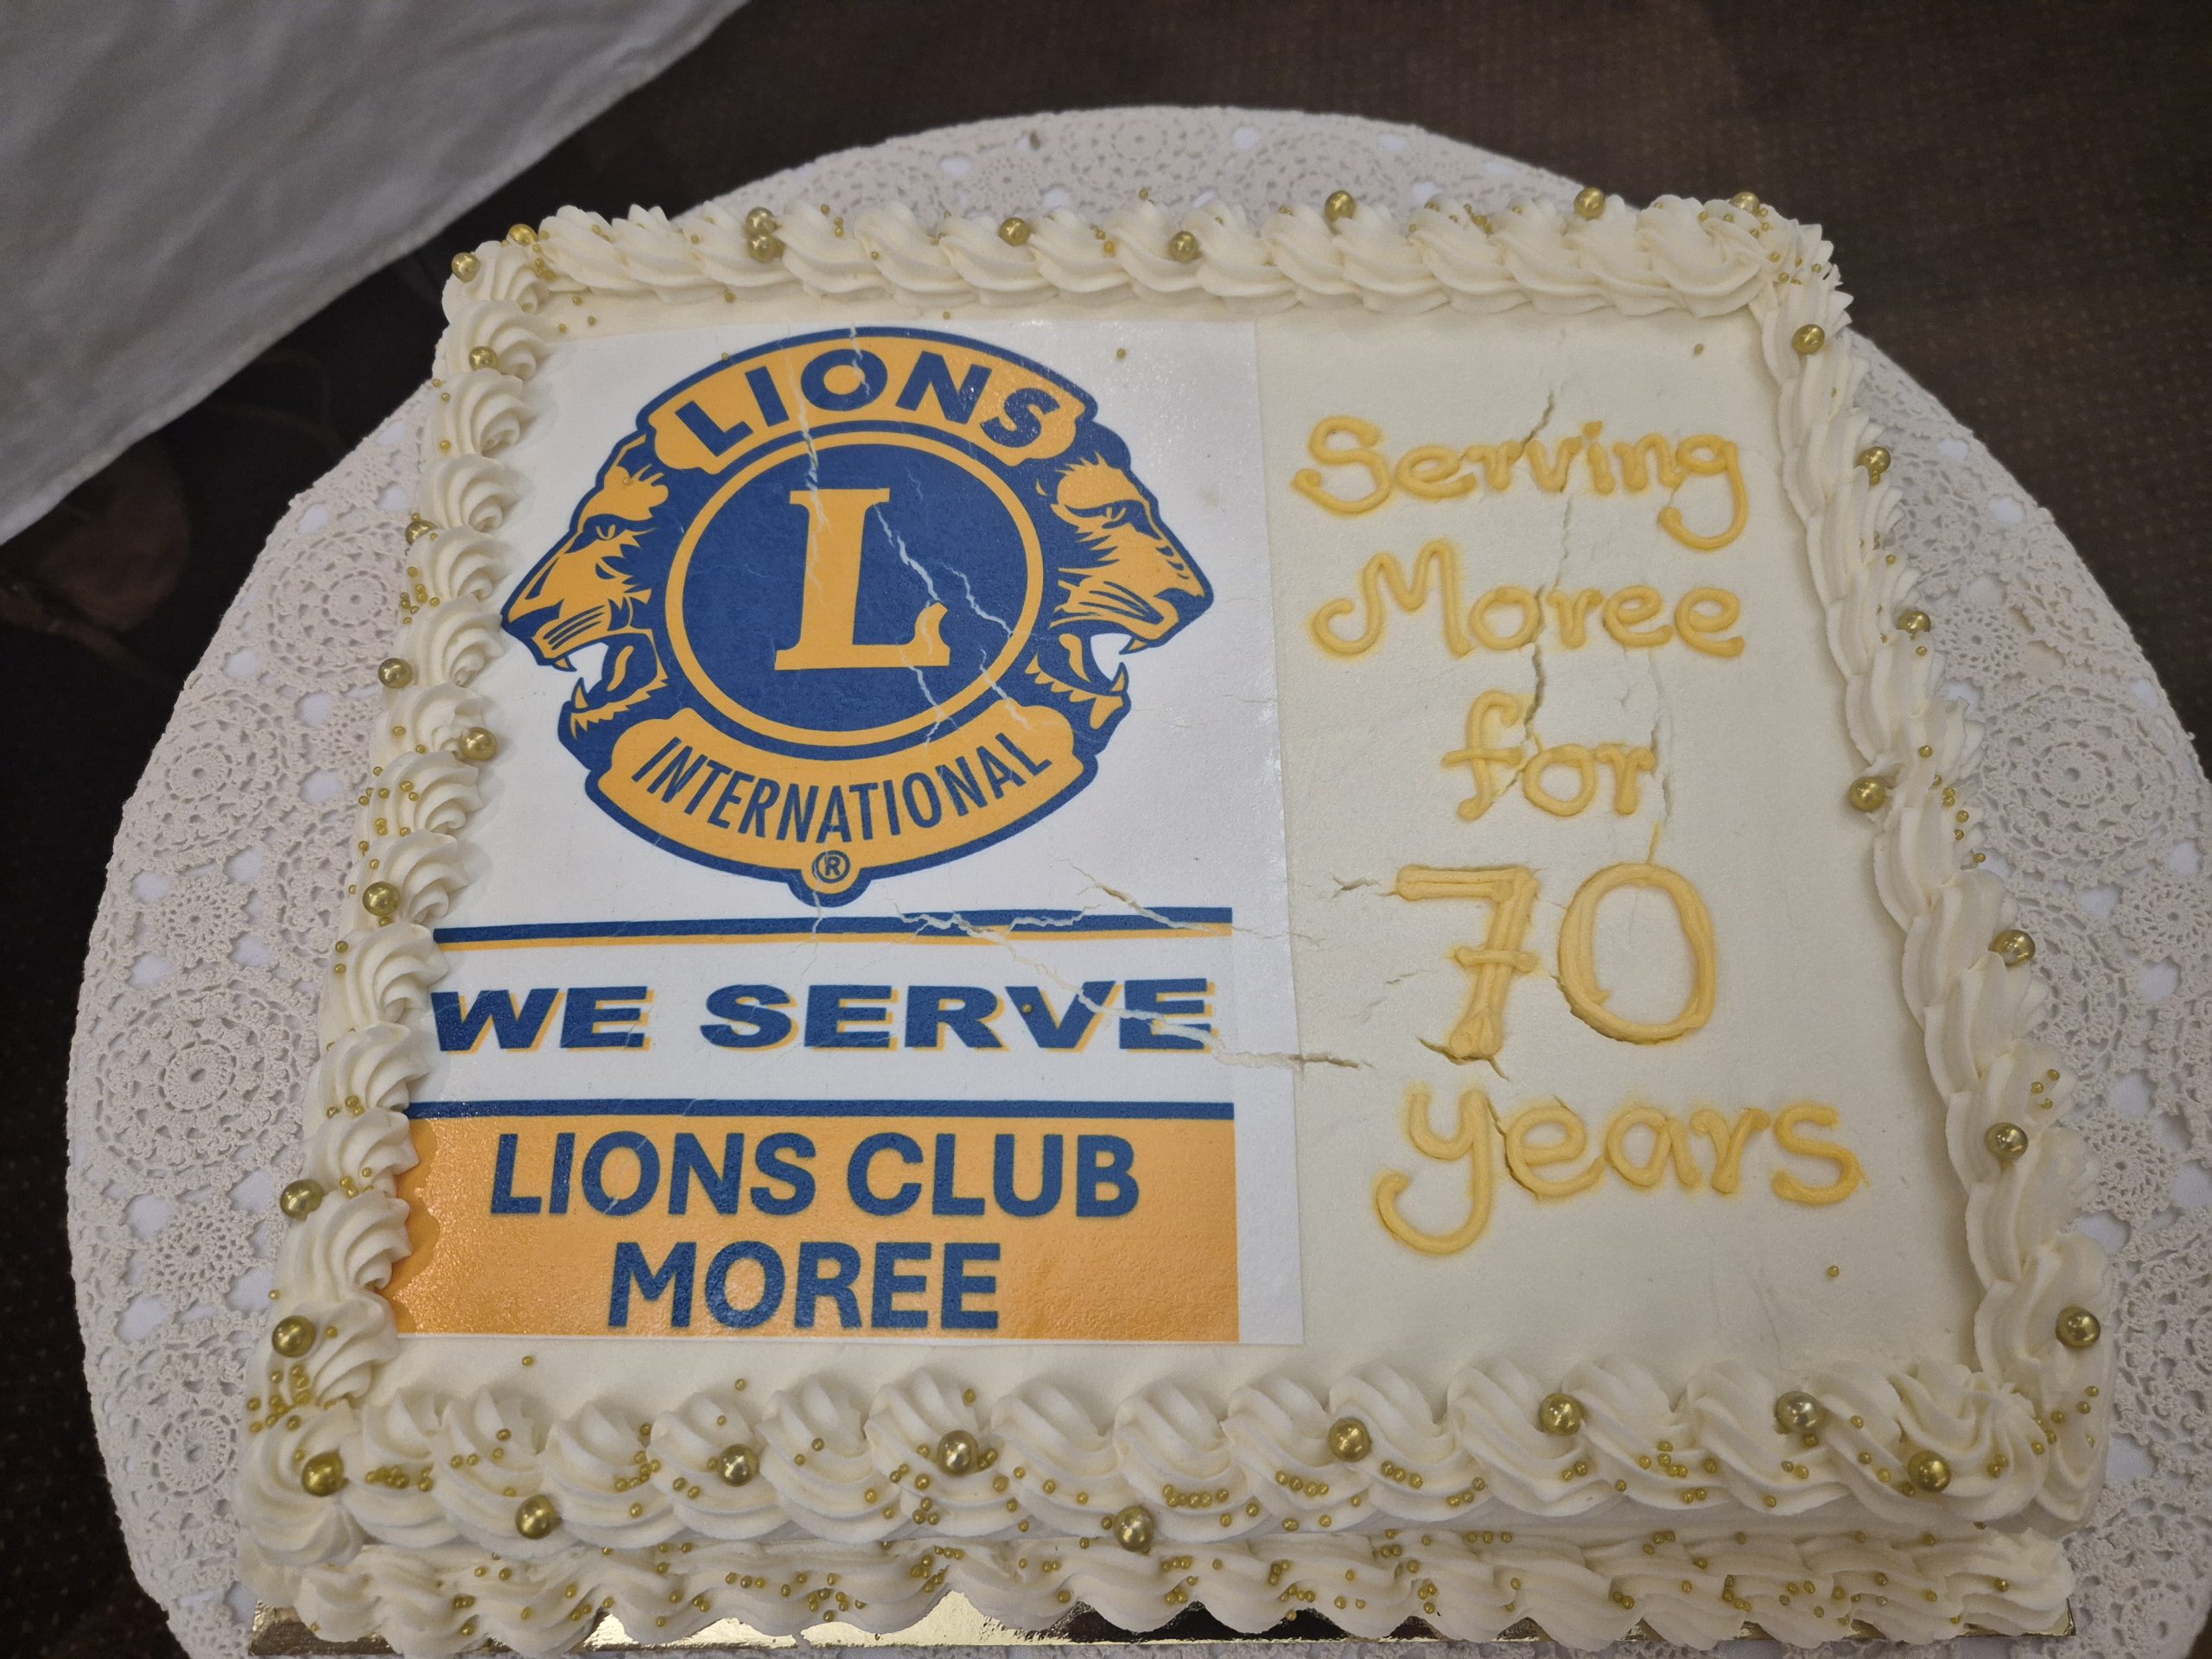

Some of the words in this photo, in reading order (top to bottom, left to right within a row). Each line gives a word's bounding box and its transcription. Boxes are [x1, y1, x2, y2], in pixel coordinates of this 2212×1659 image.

[675, 347, 1065, 458] LIONS
[1293, 415, 1748, 551] Serving
[774, 486, 951, 671] L
[1311, 539, 1745, 658] Moree
[632, 733, 1052, 844] INTERNATIONAL
[1442, 690, 1657, 821] for
[430, 985, 654, 1053] WE
[699, 977, 1217, 1053] SERVE
[1396, 861, 1718, 1061] 70
[489, 1131, 817, 1217] LIONS
[847, 1131, 1141, 1218] CLUB
[1375, 1086, 1862, 1255] years
[607, 1241, 1002, 1331] MOREE
